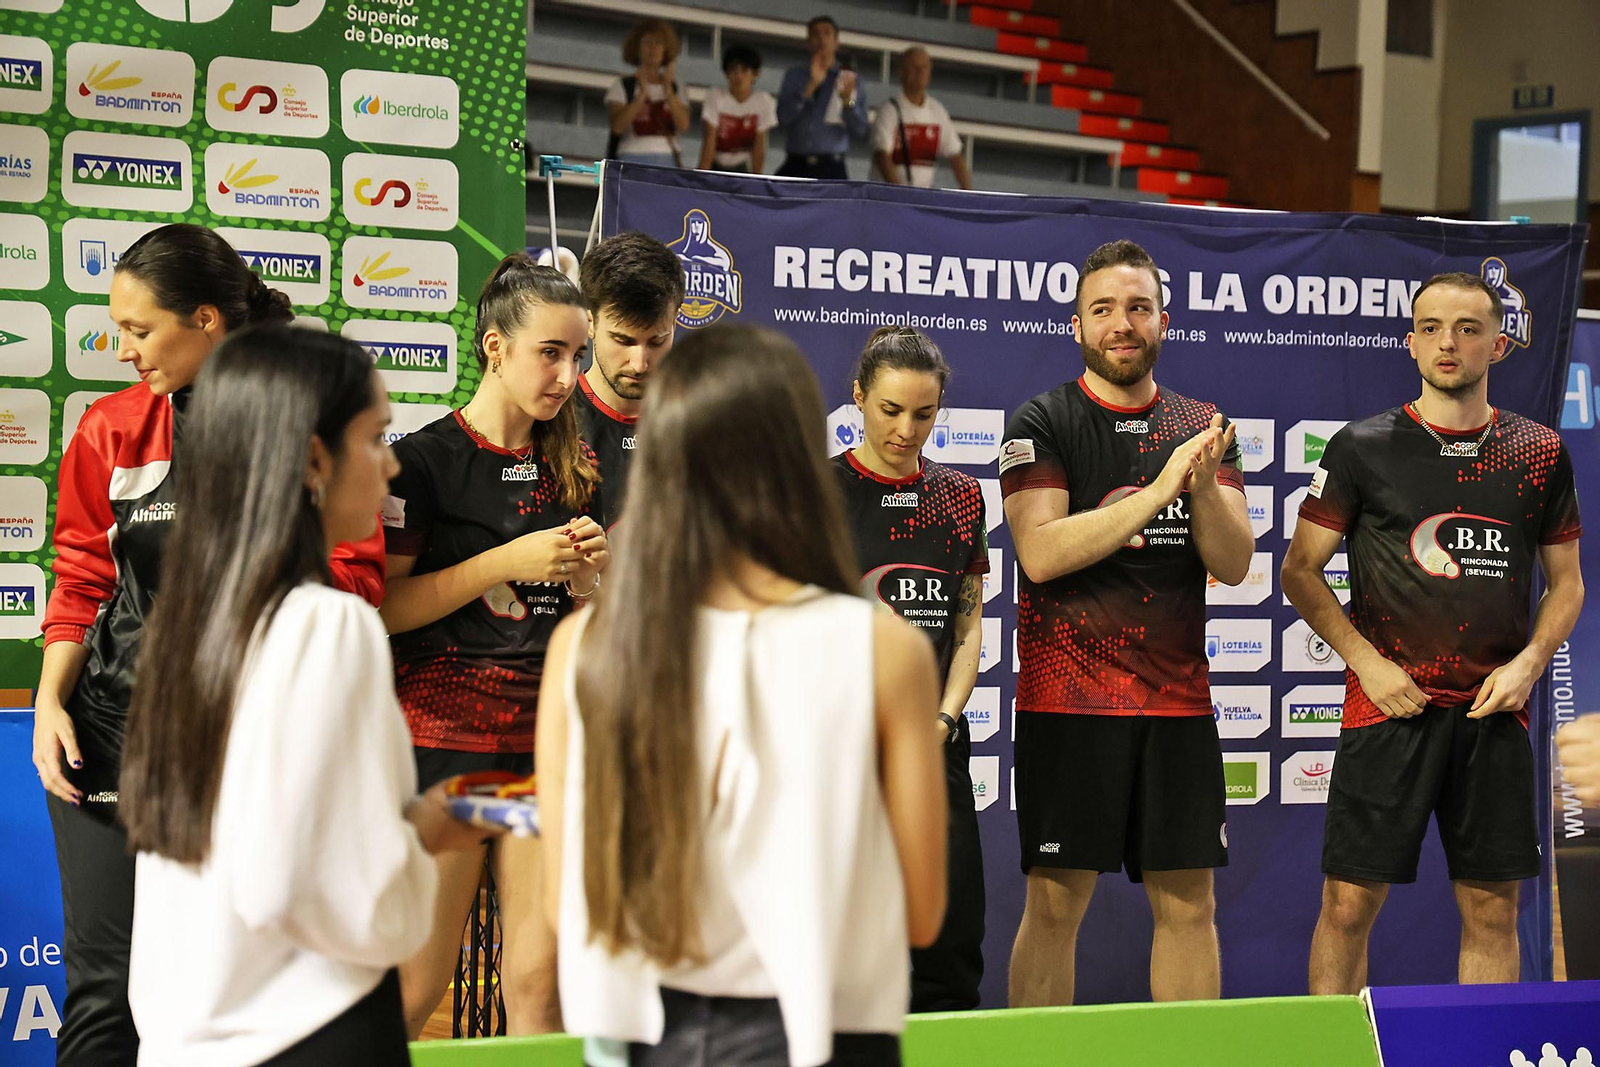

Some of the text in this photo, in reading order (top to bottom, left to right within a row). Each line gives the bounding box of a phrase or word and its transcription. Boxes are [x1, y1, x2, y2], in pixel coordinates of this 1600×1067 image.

[347, 4, 419, 27] Superior
[344, 25, 449, 50] de Deportes
[151, 90, 183, 100] ESPAÑA
[95, 94, 182, 114] BADMINTON
[384, 100, 449, 120] Iberdrola
[115, 161, 175, 186] YONEX
[234, 192, 320, 209] BADMINTON
[289, 188, 320, 196] ESPAÑA
[259, 256, 315, 278] YONEX
[418, 279, 448, 287] ESPAÑA
[773, 245, 1079, 304] RECREATIVO
[1188, 271, 1248, 313] LA
[368, 285, 448, 300] BADMINTON
[774, 306, 988, 332] www.badmintonlaorden.es
[1224, 329, 1409, 349] www.badmintonlaorden.e
[388, 347, 442, 368] YONEX
[1144, 527, 1189, 536] RINCONADA
[1149, 537, 1185, 545] (SEVILLA)
[1460, 557, 1509, 567] RINCONADA
[1465, 568, 1504, 579] (SEVILLA)
[904, 609, 948, 617] RINCONADA
[909, 620, 944, 628] (SEVILLA)
[1313, 706, 1343, 720] YONEX
[19, 937, 61, 966] de
